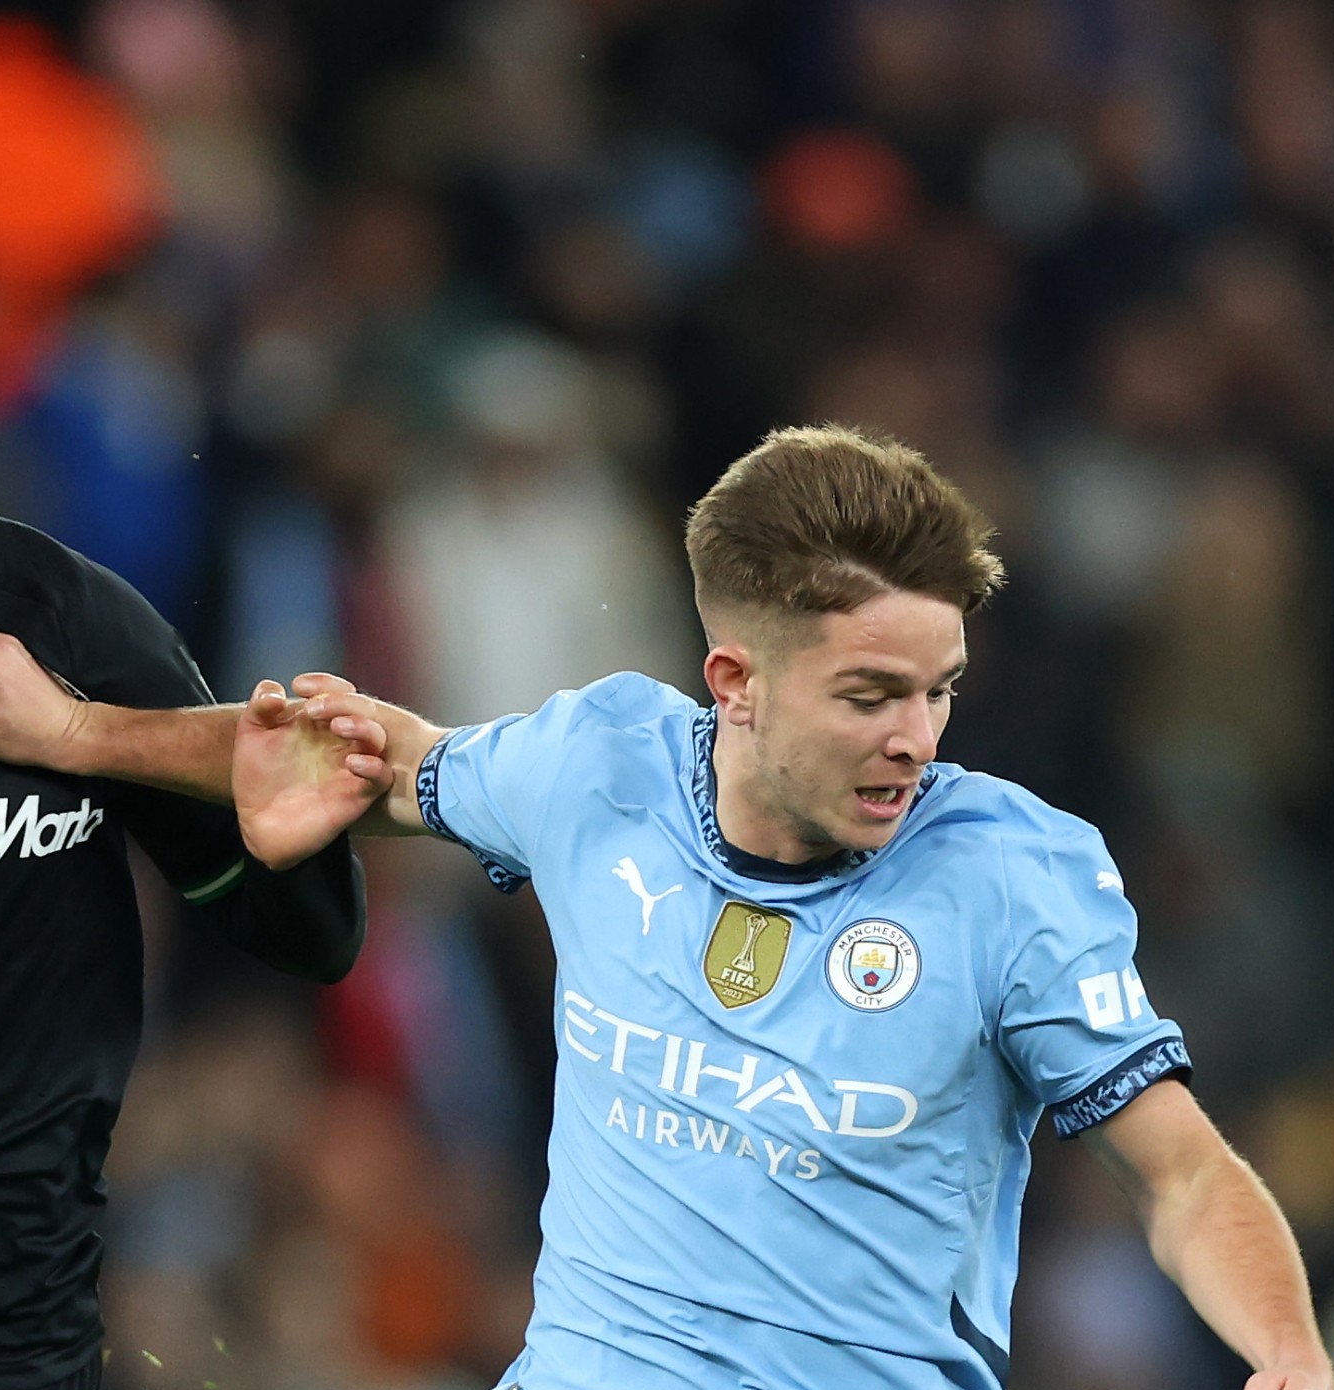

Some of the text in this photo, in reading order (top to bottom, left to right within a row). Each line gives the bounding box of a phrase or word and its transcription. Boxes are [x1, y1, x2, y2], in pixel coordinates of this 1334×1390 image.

[838, 925, 913, 957] MANCHESTER
[720, 967, 756, 989] FIFA
[855, 995, 883, 1006] CITY
[563, 989, 919, 1138] ETIHAD
[605, 1096, 821, 1180] AIRWAYS
